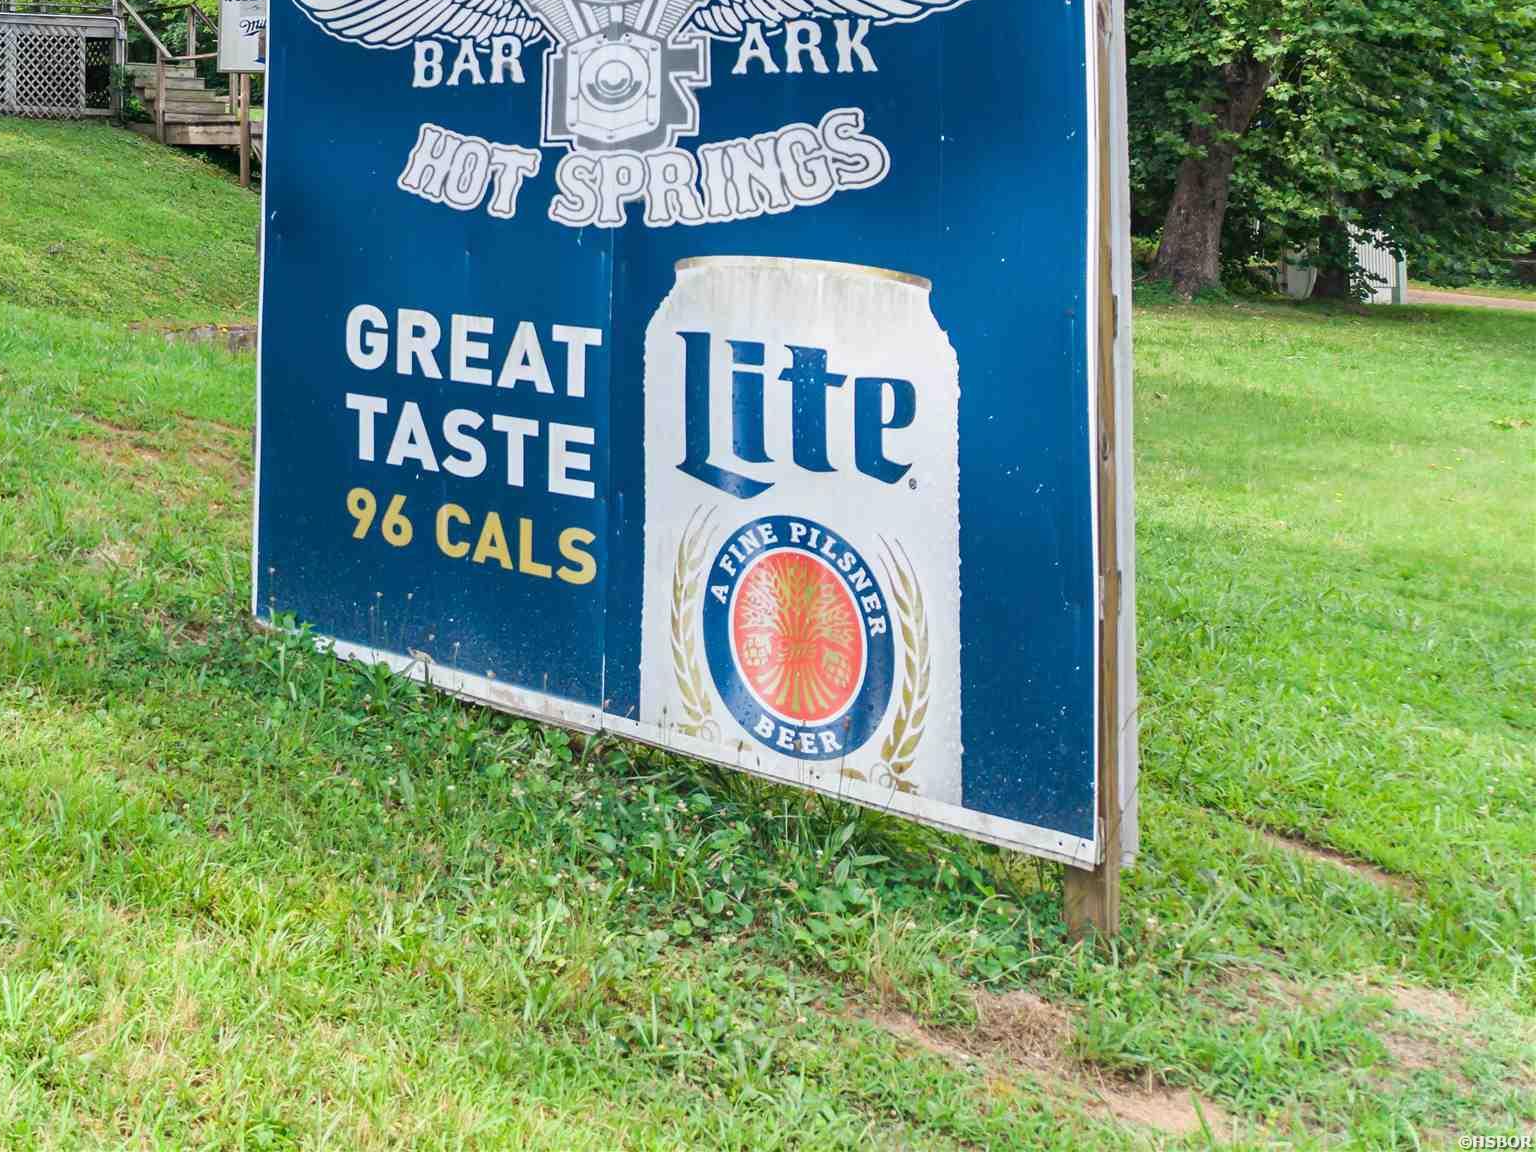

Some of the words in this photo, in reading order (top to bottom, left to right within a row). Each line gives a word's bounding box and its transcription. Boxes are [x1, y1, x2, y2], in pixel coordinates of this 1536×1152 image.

[410, 35, 526, 88] BAR
[732, 19, 879, 77] ARK
[397, 122, 542, 218] HOT
[548, 107, 891, 228] SPRINGS
[345, 304, 602, 398] GREAT
[345, 393, 596, 500] TASTE
[675, 330, 917, 500] Lite
[346, 488, 412, 547] 96
[436, 504, 598, 585] CALS
[719, 523, 778, 576] FINE
[789, 522, 887, 637] PILSNER
[711, 585, 729, 604] A
[753, 714, 842, 753] BEER
